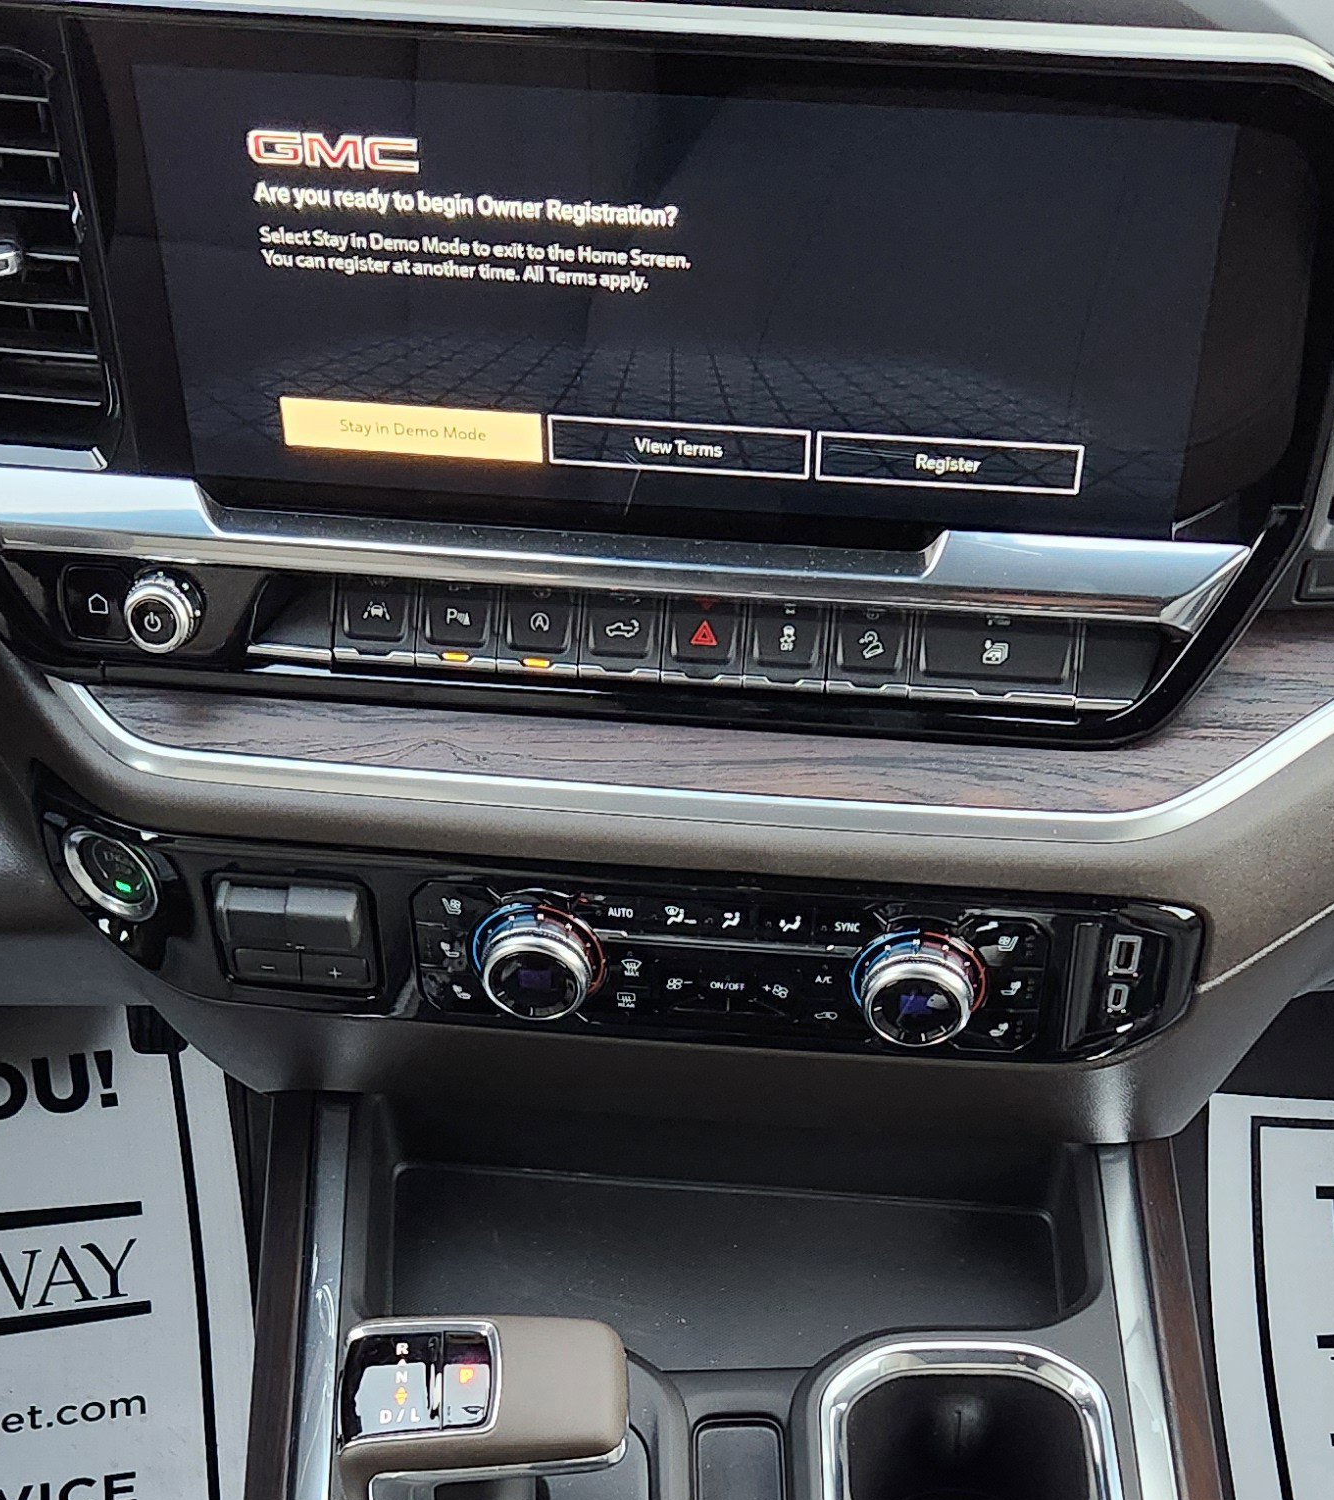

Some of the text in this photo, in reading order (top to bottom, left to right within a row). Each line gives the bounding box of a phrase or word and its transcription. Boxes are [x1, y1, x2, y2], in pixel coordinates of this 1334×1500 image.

[247, 129, 419, 174] GMC
[254, 181, 679, 227] Are you ready to begin Owner Registration?
[259, 226, 692, 270] Select Stay in Demo Mode to exit to the Home Screen.
[260, 249, 650, 293] You can register at another time. All Terms apply.
[340, 419, 487, 442] Stay in Demo Mode
[634, 437, 723, 458] View Terms
[915, 453, 982, 475] Register
[608, 906, 634, 918] AUTO
[835, 921, 860, 934] SYNC
[709, 981, 745, 992] ON/OFF
[815, 974, 833, 985] A/C
[395, 1342, 409, 1355] R
[395, 1367, 474, 1384] N P
